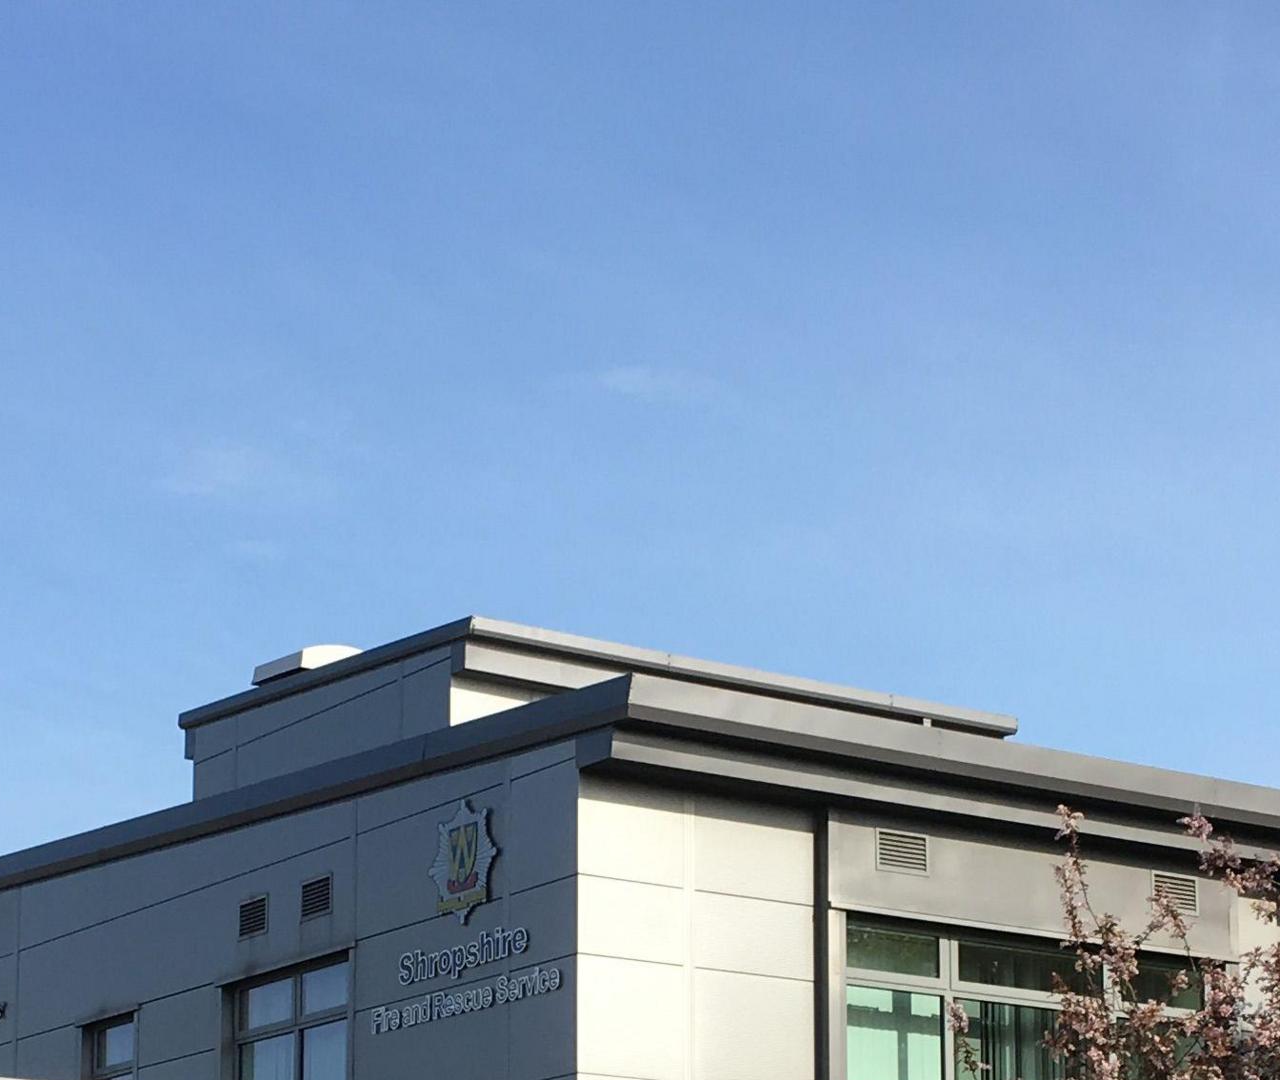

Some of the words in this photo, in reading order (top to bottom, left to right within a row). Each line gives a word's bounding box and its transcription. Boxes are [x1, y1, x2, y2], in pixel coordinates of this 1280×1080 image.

[399, 927, 528, 986] Shropshire
[371, 1006, 400, 1035] Fire
[402, 994, 431, 1028] and
[432, 986, 493, 1019] Rescue
[495, 967, 561, 1004] Service
